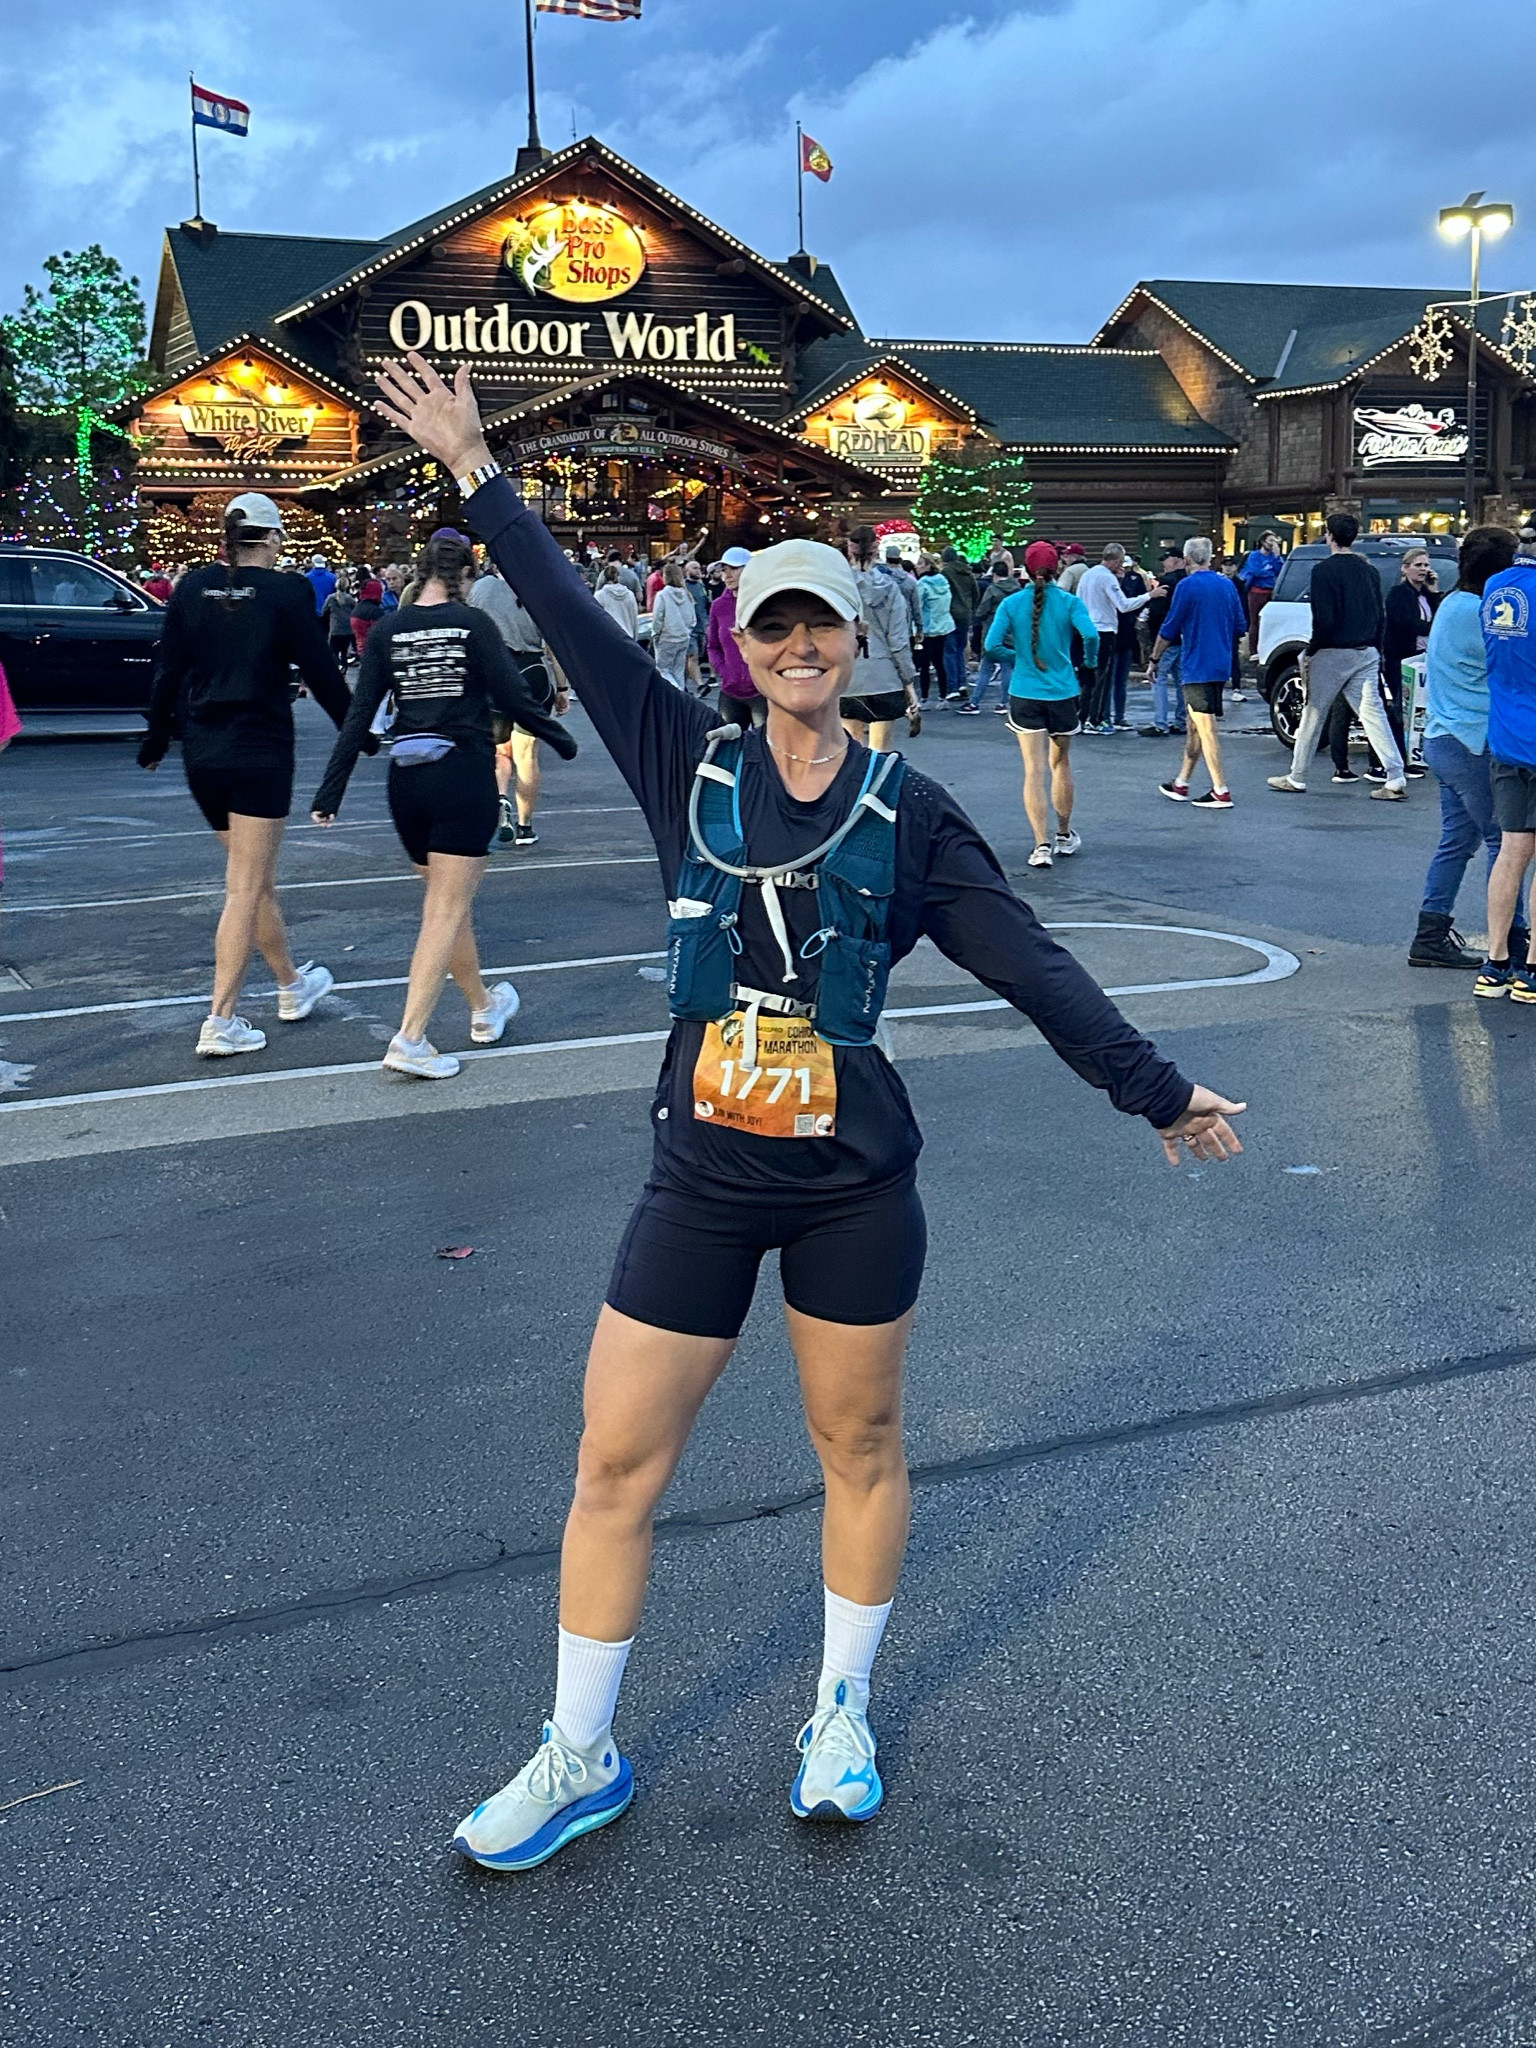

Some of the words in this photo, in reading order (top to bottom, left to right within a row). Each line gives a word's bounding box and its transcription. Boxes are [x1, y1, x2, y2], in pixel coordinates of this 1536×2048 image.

[561, 207, 615, 235] Bass
[566, 234, 606, 260] Pro
[566, 259, 632, 290] Shops
[389, 300, 591, 358] Outdoor
[602, 310, 737, 363] World
[189, 407, 251, 432] White
[254, 407, 309, 435] River
[518, 442, 539, 455] THE
[539, 429, 591, 452] GRANDADDY
[640, 430, 657, 442] ALL
[658, 431, 699, 449] OUTDOOR
[699, 440, 730, 459] STORES
[670, 937, 682, 994] NATHAN
[863, 960, 878, 1014] NATHAN
[764, 1040, 818, 1054] MARATHON
[719, 1059, 811, 1105] 1771
